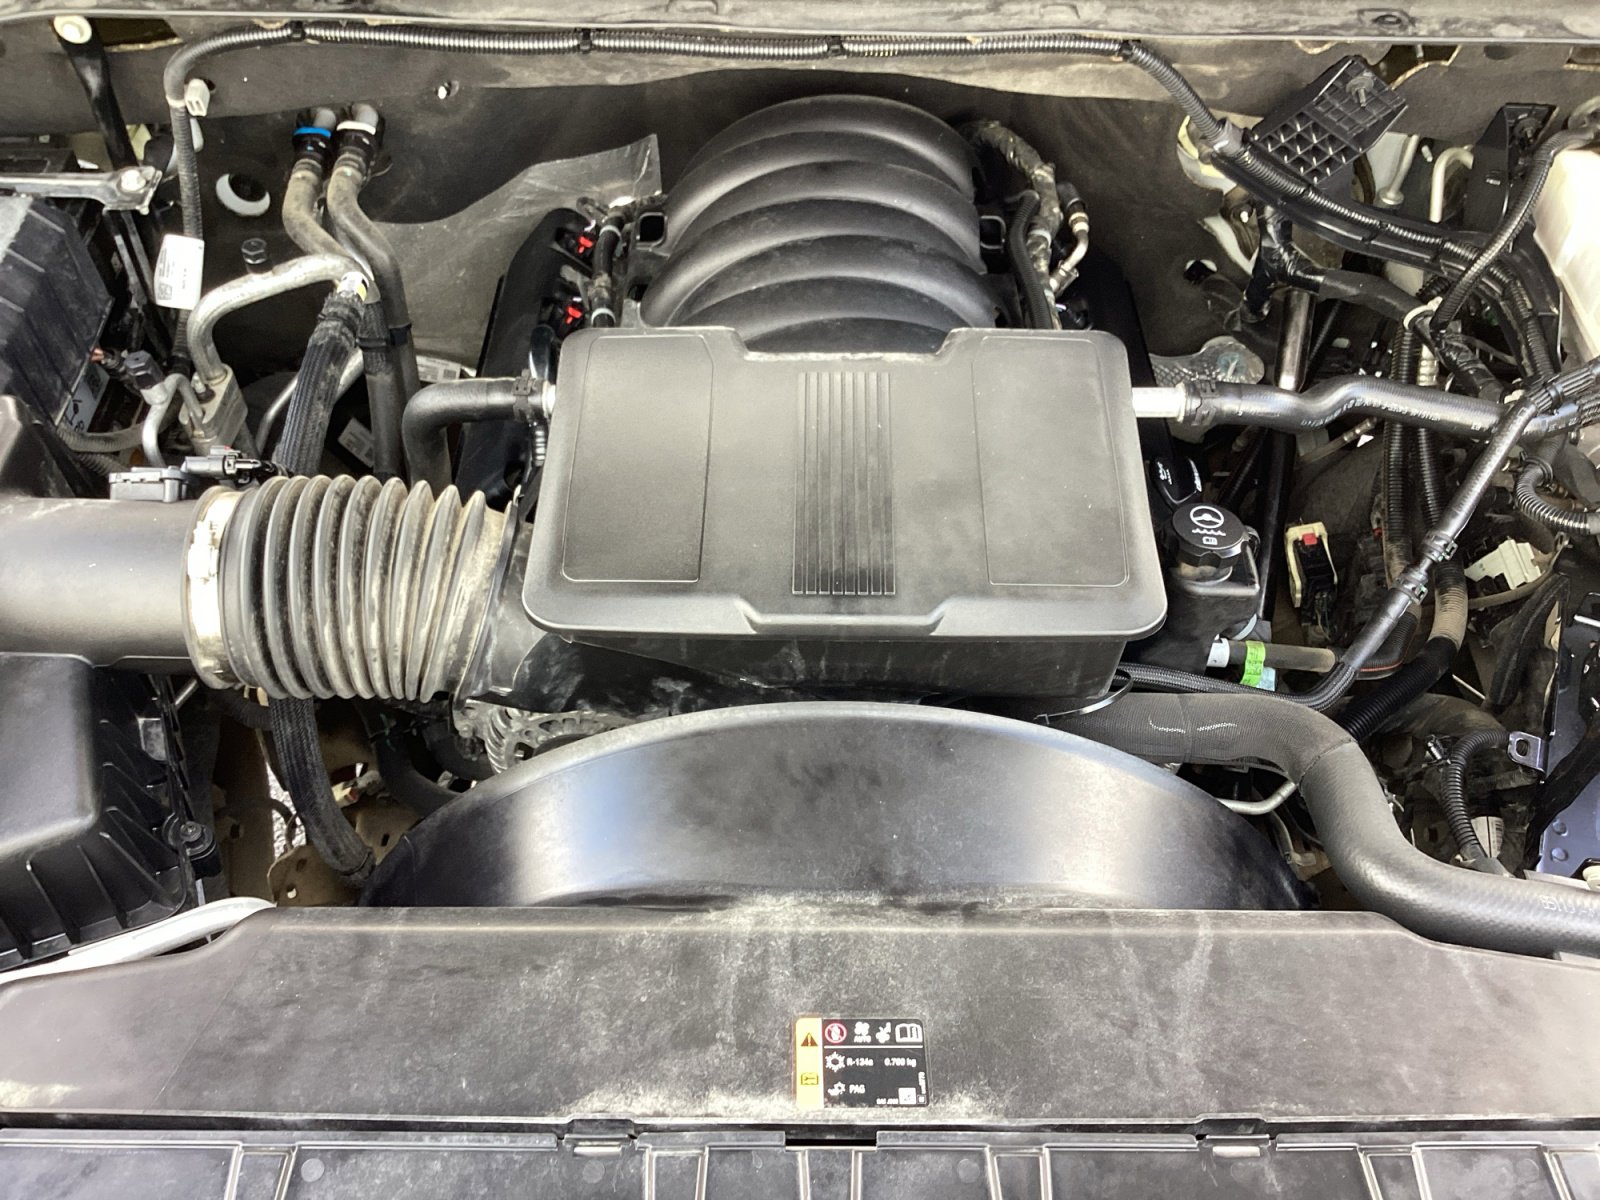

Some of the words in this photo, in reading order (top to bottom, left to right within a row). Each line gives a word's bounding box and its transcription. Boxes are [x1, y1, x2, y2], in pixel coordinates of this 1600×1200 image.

[846, 1058, 874, 1067] R-134a
[907, 1058, 917, 1068] kg
[849, 1084, 866, 1094] PAG
